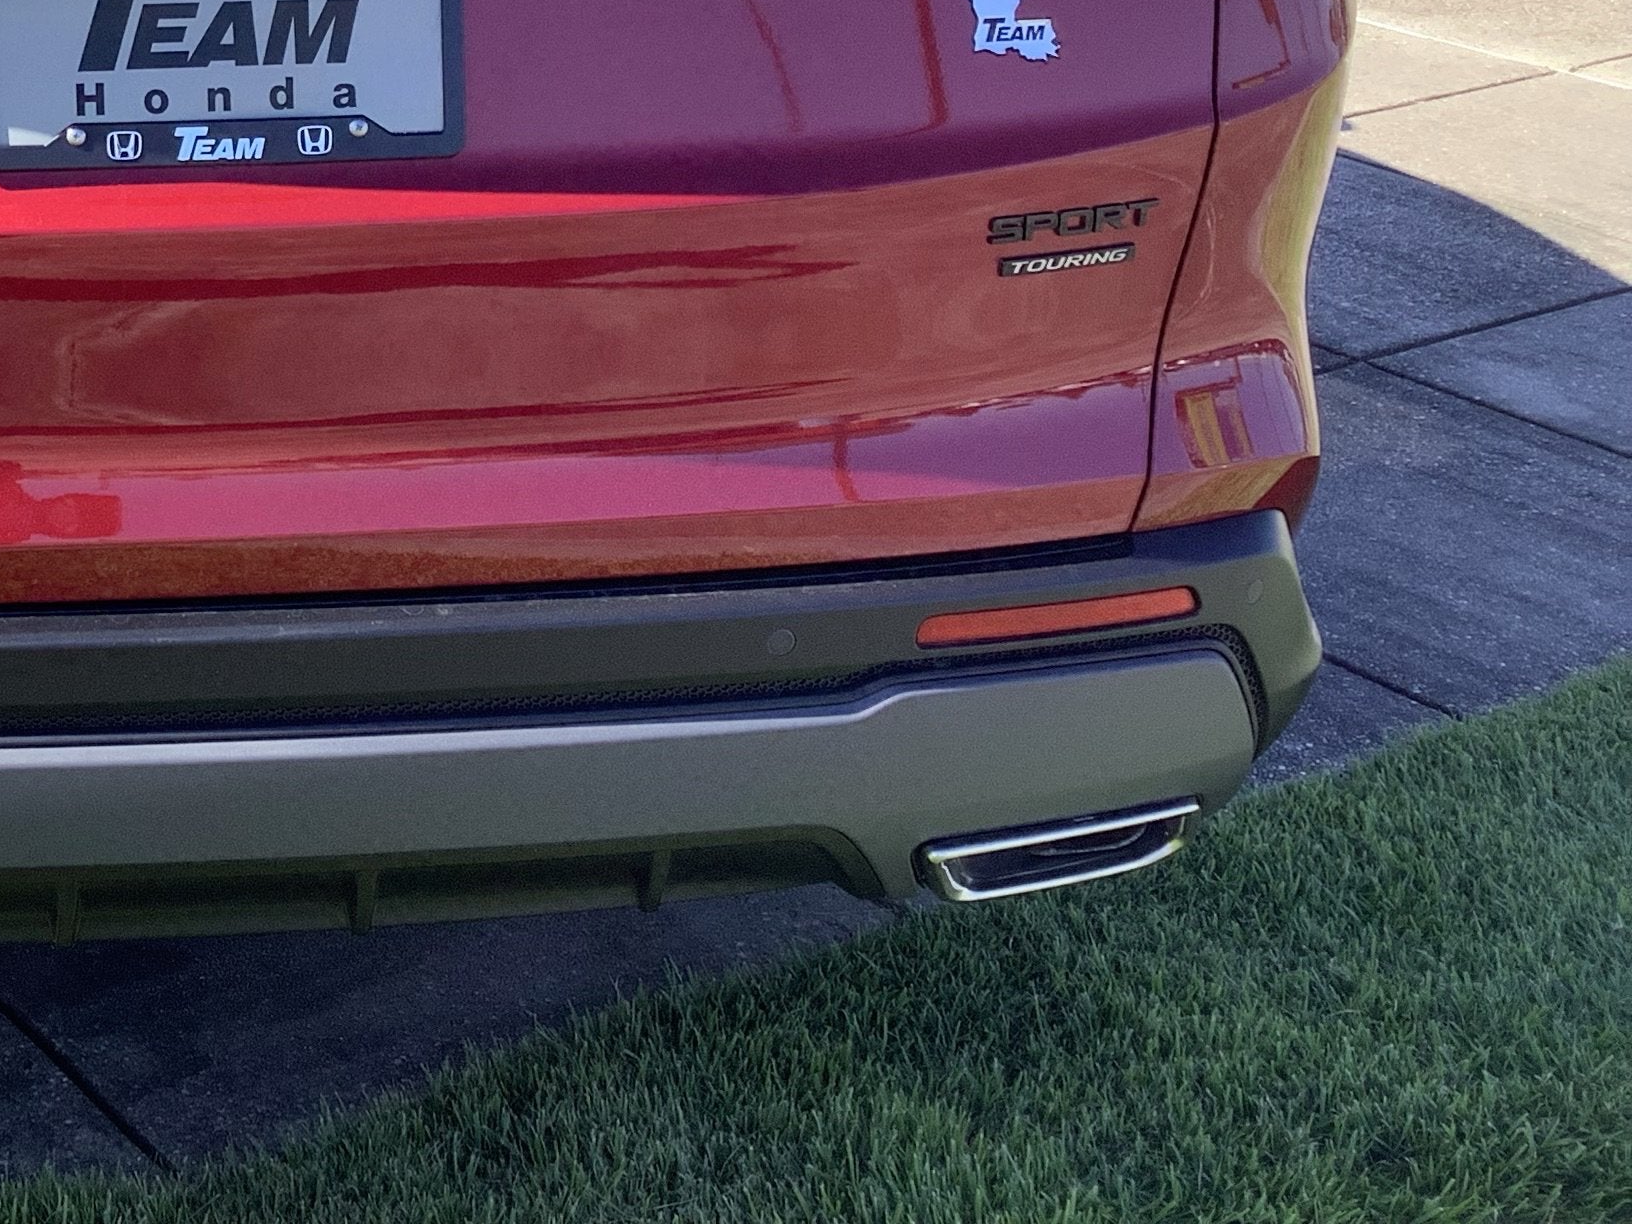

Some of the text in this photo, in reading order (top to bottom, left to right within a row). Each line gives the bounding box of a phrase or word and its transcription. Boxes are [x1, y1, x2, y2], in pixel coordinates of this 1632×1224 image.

[982, 17, 1046, 43] TEAM
[75, 76, 358, 117] Honda
[173, 126, 266, 162] TEAM
[986, 197, 1160, 245] SPORT
[1011, 247, 1129, 275] TOURING
